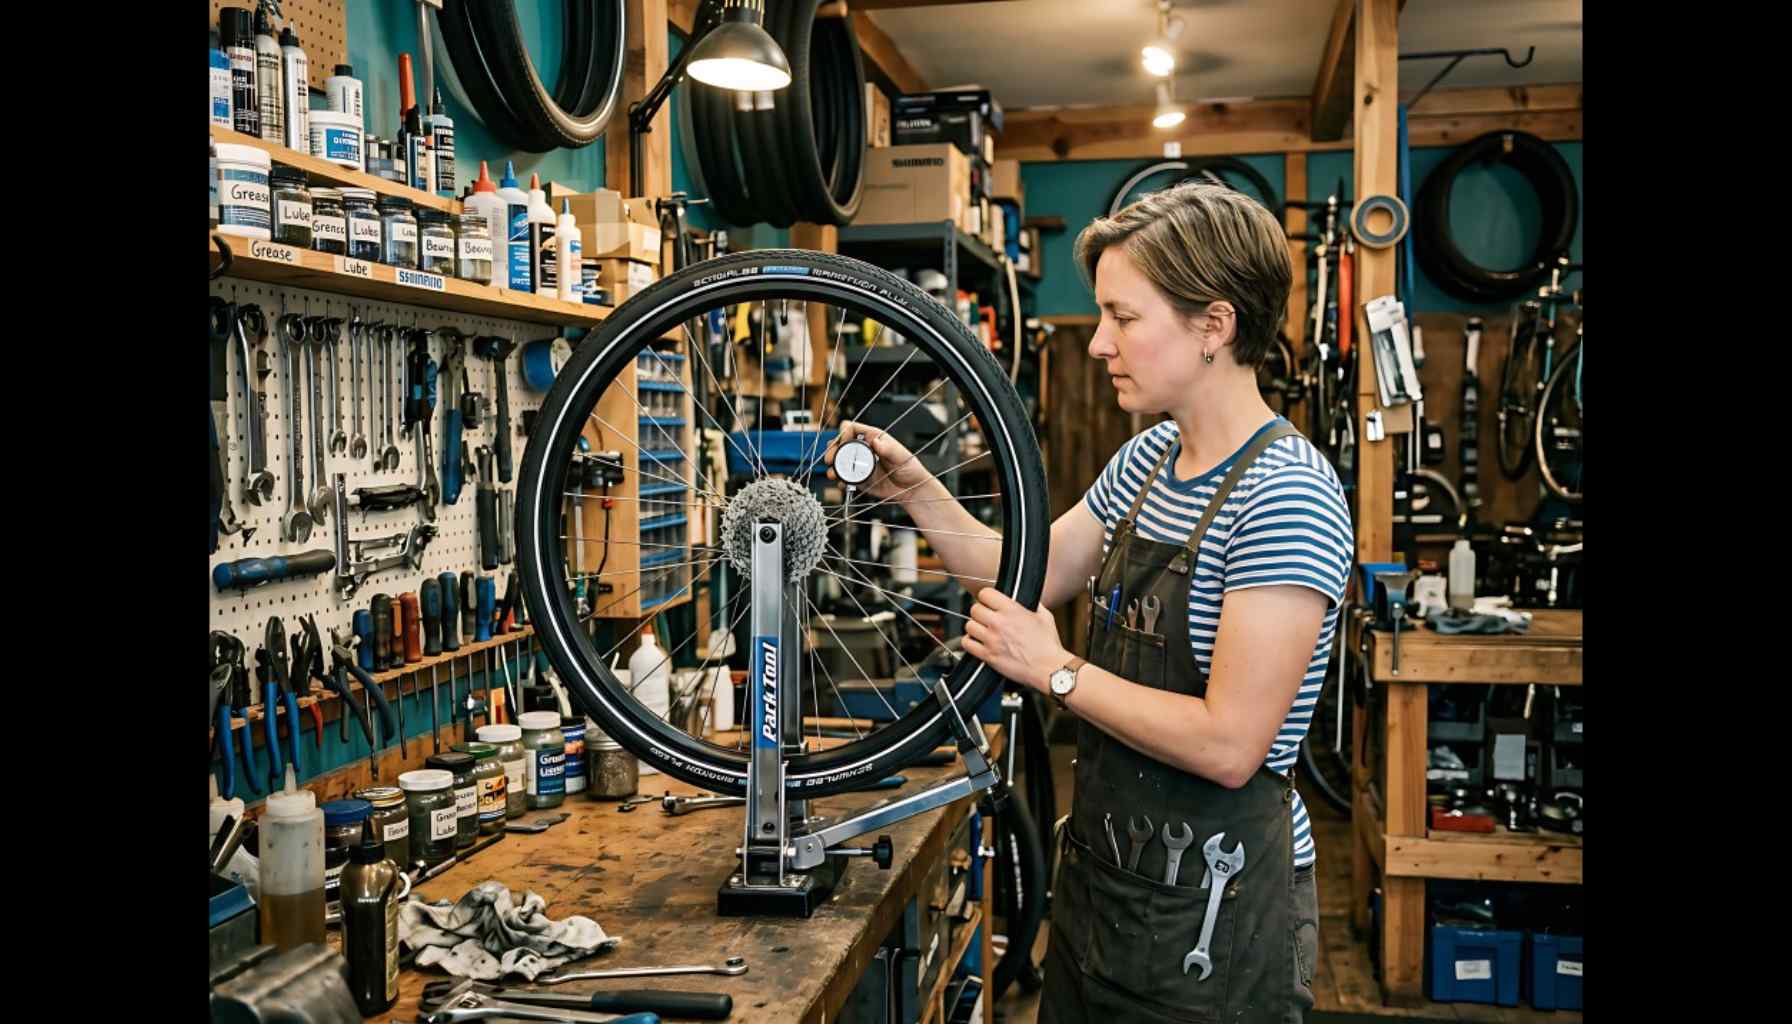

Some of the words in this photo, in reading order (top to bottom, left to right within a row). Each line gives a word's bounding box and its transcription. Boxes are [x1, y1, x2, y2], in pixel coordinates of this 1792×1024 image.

[251, 240, 293, 261] Grease
[343, 258, 368, 276] Lube
[763, 641, 777, 688] Tool
[763, 693, 777, 743] Park
